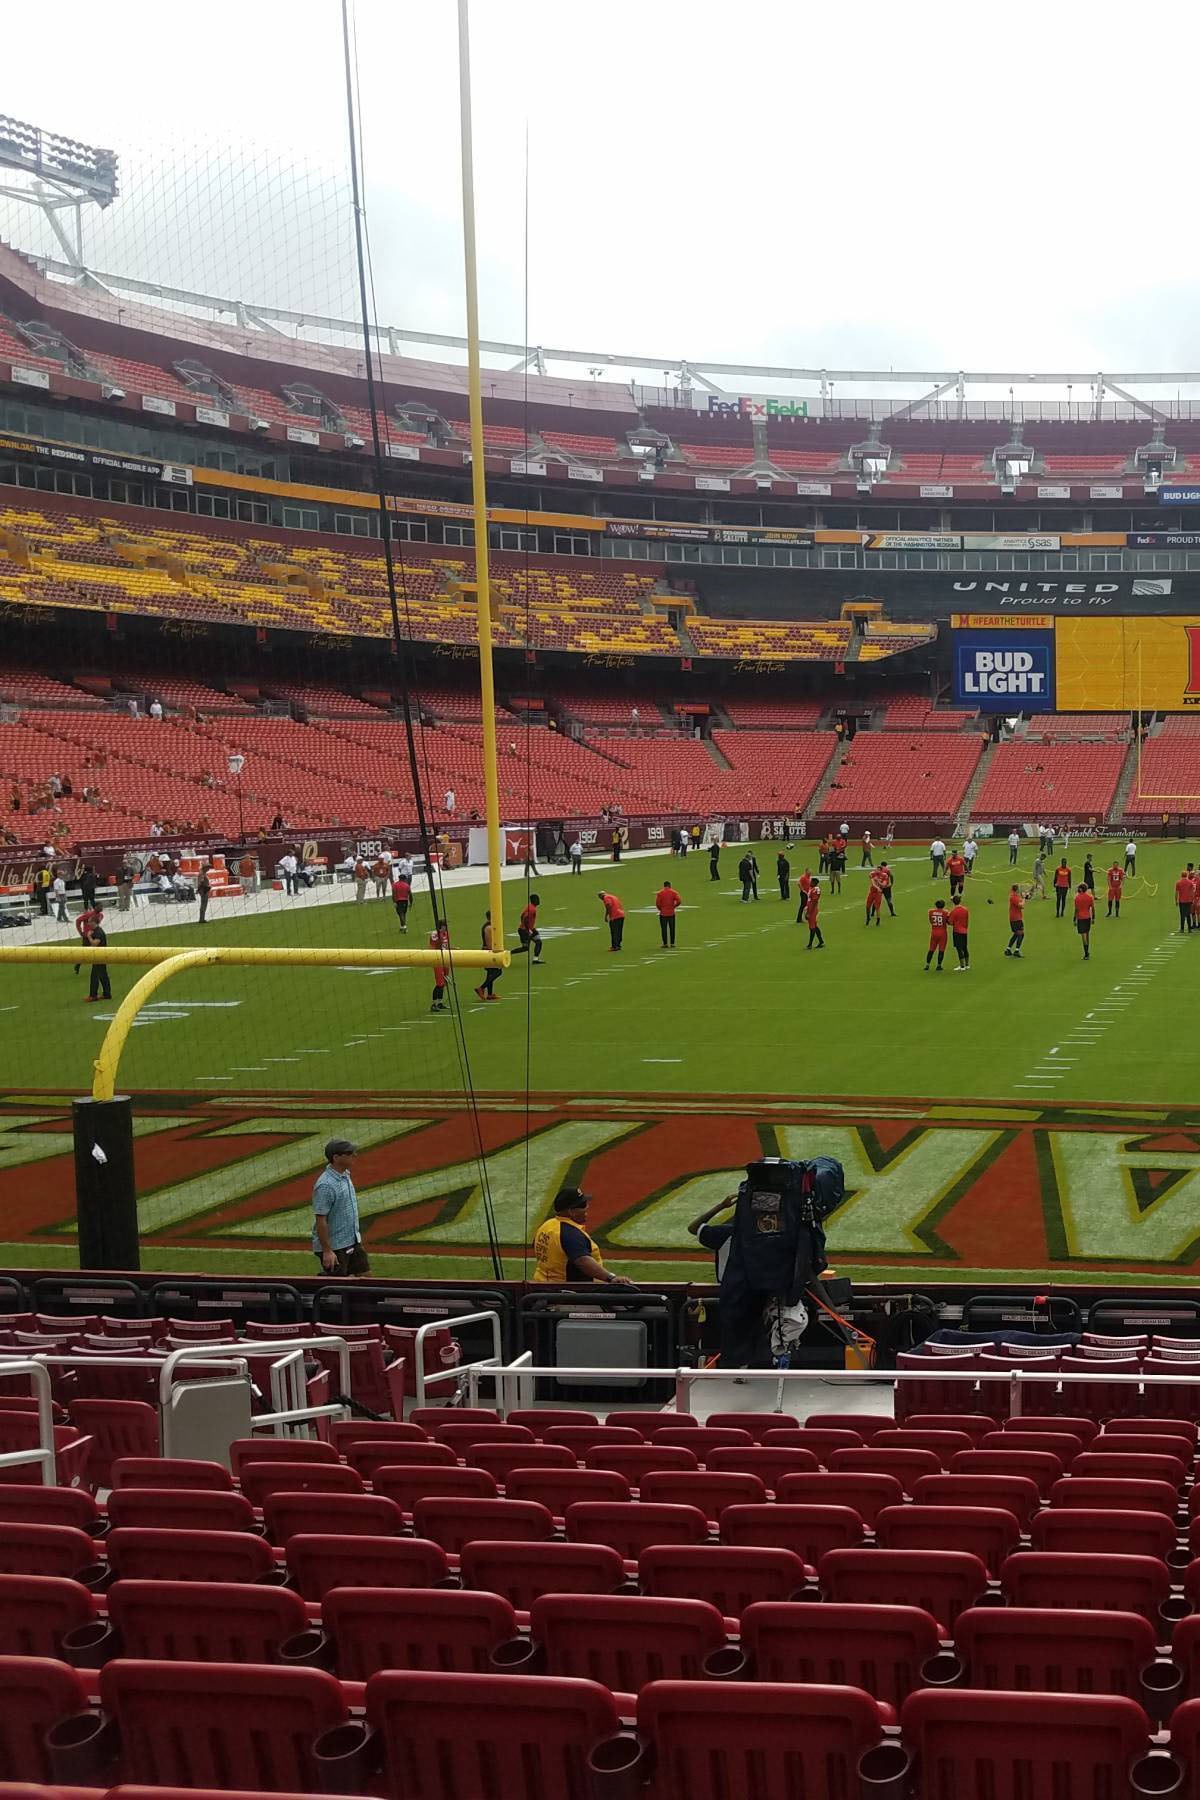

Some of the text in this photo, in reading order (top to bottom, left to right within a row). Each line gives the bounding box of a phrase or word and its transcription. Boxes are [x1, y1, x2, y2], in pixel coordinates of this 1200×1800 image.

[708, 396, 807, 417] FedExField
[0, 438, 35, 453] OWNLOAD
[36, 446, 50, 455] THE
[1164, 492, 1181, 500] BUD
[1137, 536, 1156, 544] FedEx
[1167, 536, 1193, 544] PROUD
[953, 581, 1119, 593] UNITED
[1000, 596, 1112, 605] Proud to fly
[973, 617, 1046, 626] #FEARTHETURTLE
[975, 652, 1033, 672] BUD
[964, 672, 1042, 693] LIGHT
[578, 830, 597, 844] 1987
[647, 827, 665, 839] 1991
[773, 827, 806, 835] SAUTE
[356, 841, 382, 857] 1983
